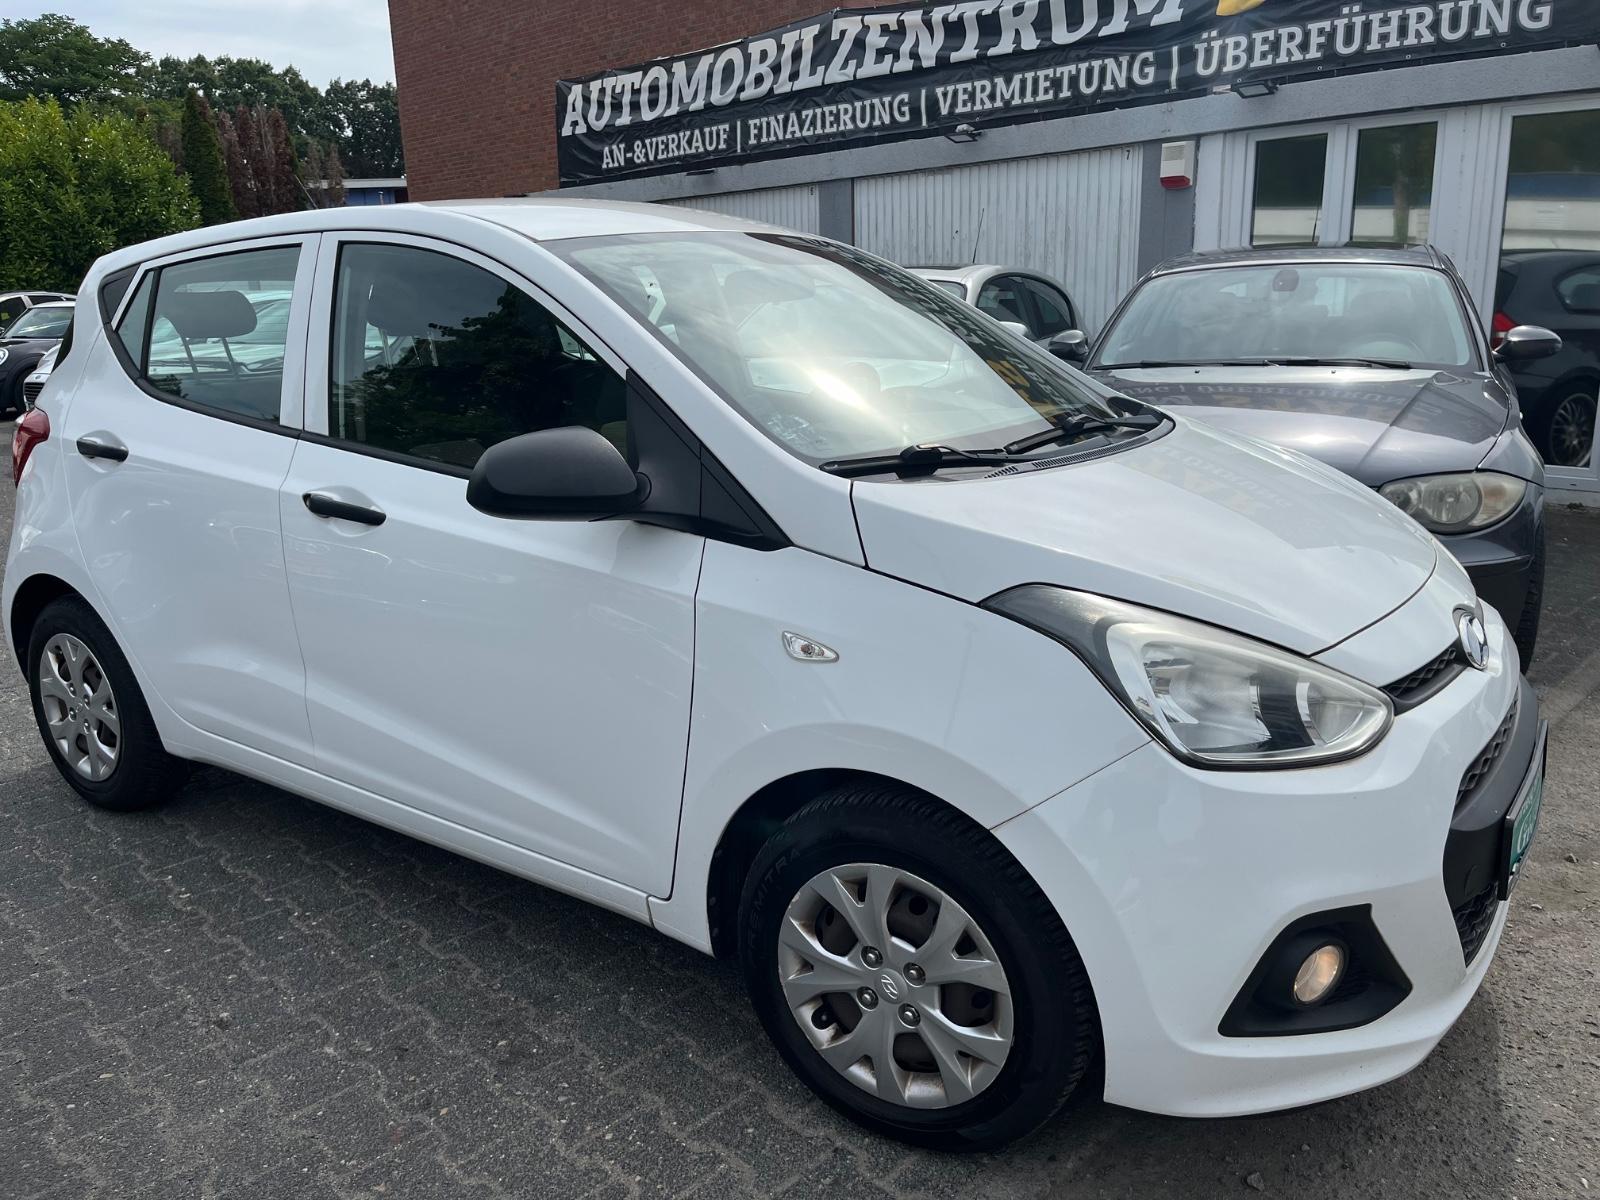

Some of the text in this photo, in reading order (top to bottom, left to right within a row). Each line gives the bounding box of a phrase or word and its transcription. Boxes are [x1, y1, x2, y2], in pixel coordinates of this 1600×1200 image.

[561, 0, 1183, 137] AUTOMOBILZENTRUM
[601, 0, 1552, 169] AN-&VERKAUF FINAZIERUNG VERMIETUNG ÜBERFÜHRUNG
